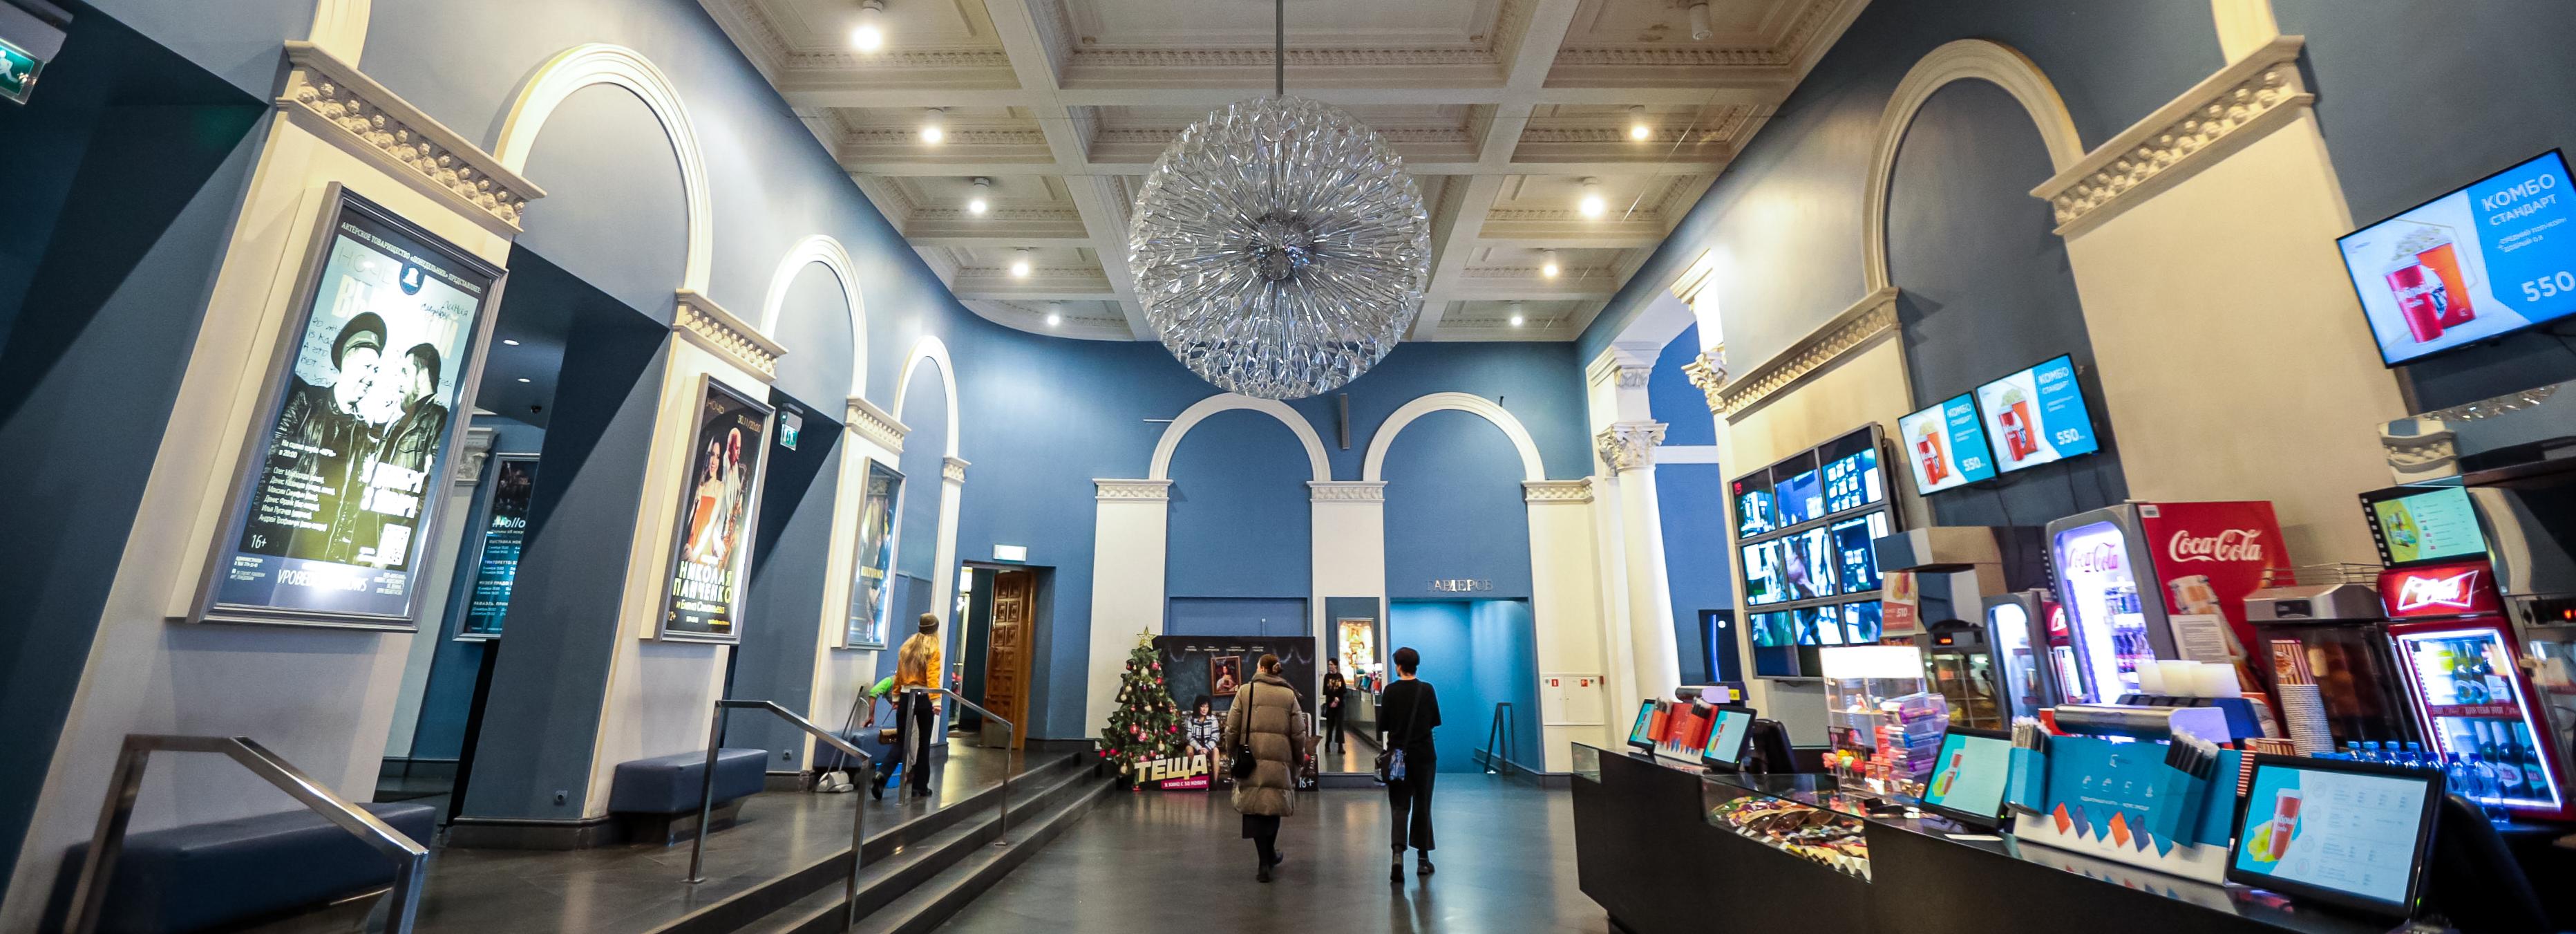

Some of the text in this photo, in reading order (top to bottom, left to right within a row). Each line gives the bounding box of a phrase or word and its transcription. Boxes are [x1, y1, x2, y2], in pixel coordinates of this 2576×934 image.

[2481, 174, 2556, 211] КОМБО
[2489, 194, 2557, 226] СТАНДАРТ
[2521, 271, 2575, 302] 550
[2056, 427, 2080, 445] 550
[1962, 456, 1981, 471] 550
[251, 534, 267, 549] 16+
[679, 560, 732, 586] НИКОЛАЯ
[672, 578, 732, 604] ПАНЧЕНКО
[1896, 607, 1908, 617] 510
[1298, 776, 1315, 788] 16+
